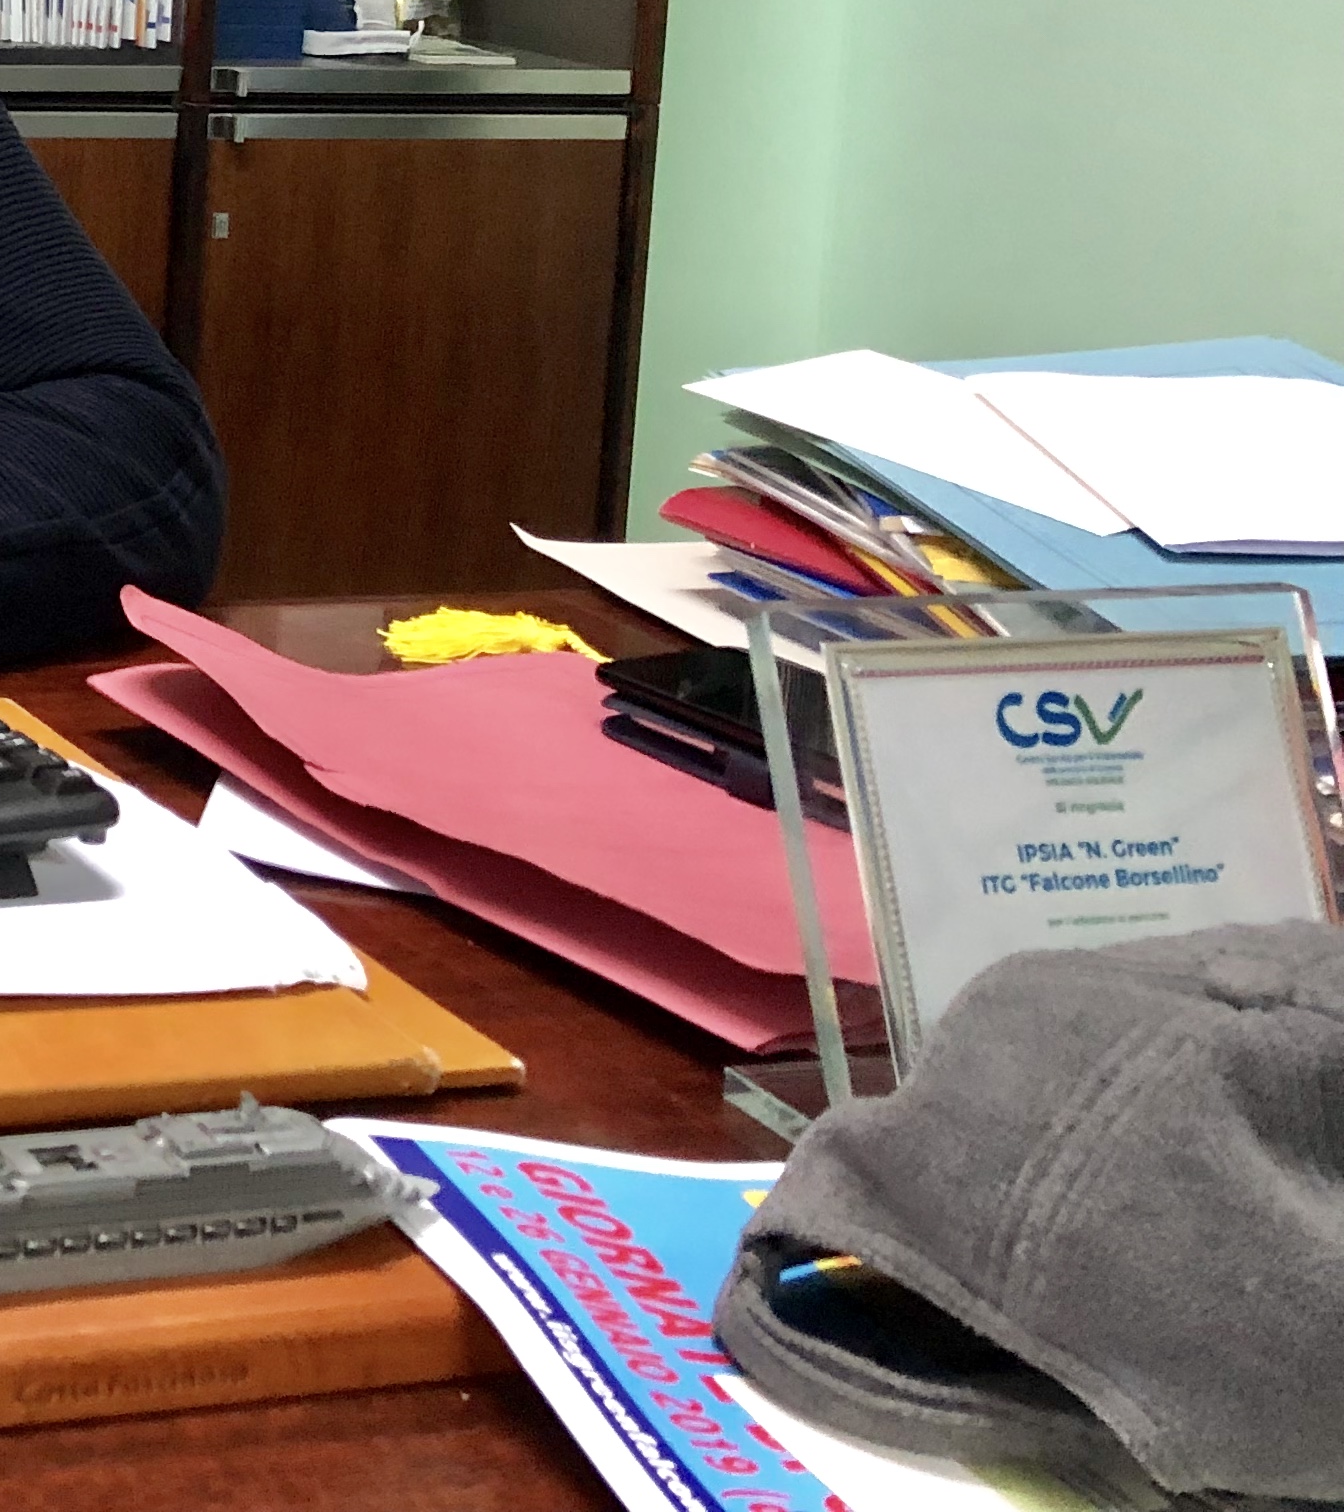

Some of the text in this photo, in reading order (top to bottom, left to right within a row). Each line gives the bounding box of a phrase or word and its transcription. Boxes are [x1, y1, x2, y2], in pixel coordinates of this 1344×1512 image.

[995, 687, 1144, 749] CSV
[1016, 842, 1075, 864] IPSIA
[980, 862, 1226, 896] ITC "Falcone Borsellino"
[447, 1149, 506, 1178] 12
[479, 1183, 514, 1199] e
[499, 1205, 566, 1243] 26
[539, 1248, 680, 1384] GENNAIO
[649, 1390, 759, 1475] 2019
